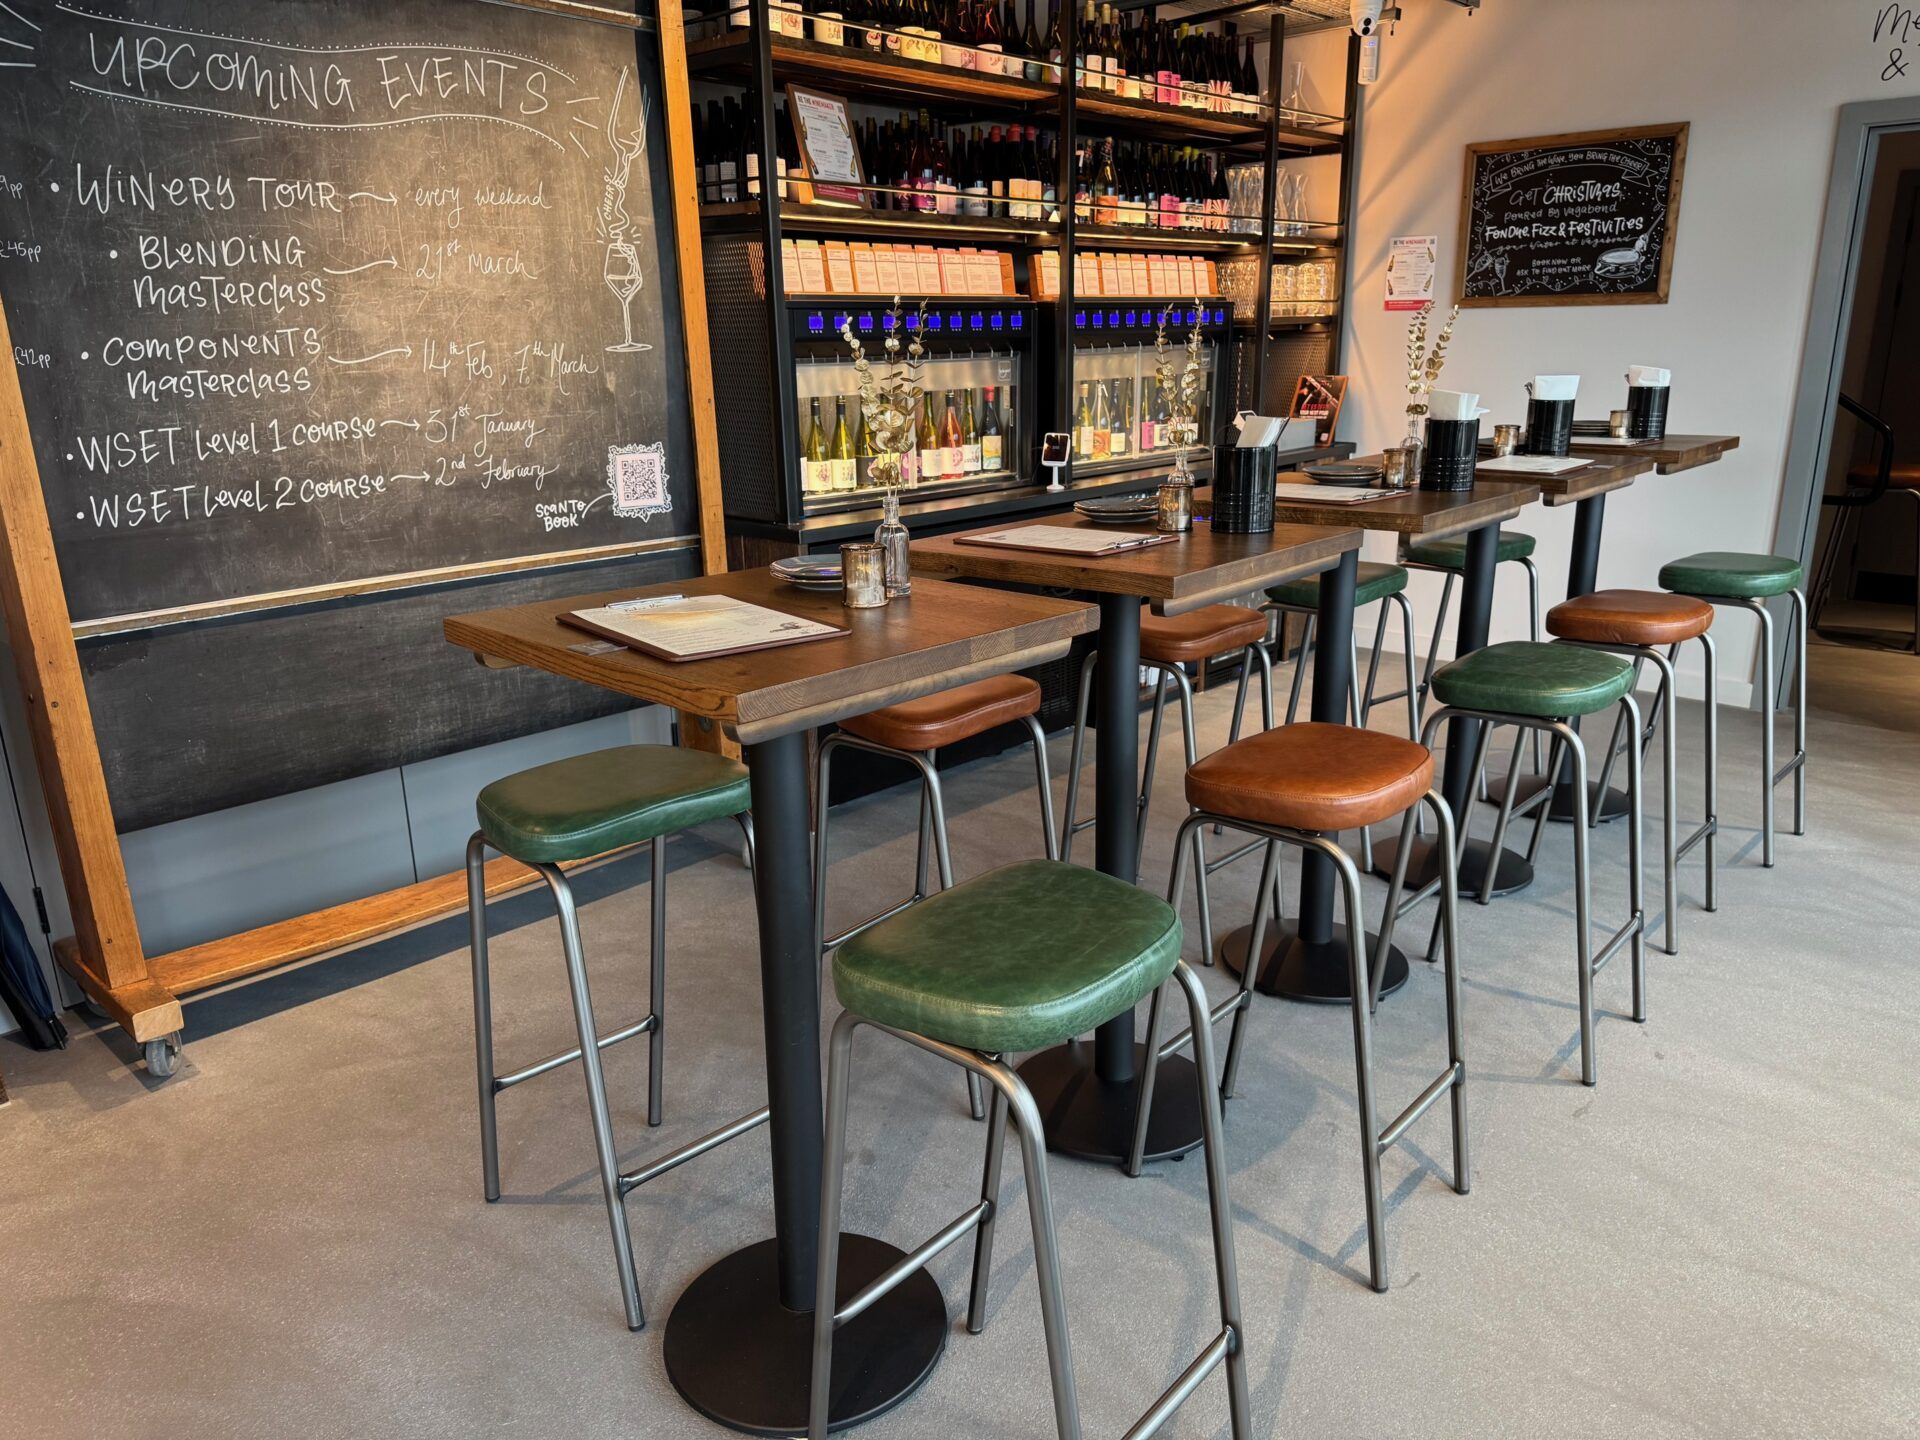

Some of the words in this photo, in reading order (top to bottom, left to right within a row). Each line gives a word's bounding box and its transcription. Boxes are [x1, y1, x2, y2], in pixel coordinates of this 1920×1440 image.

[376, 55, 549, 115] EVENTS
[1881, 48, 1910, 81] &
[415, 187, 464, 229] every
[474, 181, 552, 209] weekend
[1558, 222, 1566, 238] &
[416, 239, 461, 280] 21st
[469, 251, 538, 280] March
[14, 346, 51, 368] £42pp
[423, 338, 463, 378] 14th
[550, 343, 599, 395] March
[77, 427, 182, 475] WSET
[269, 419, 288, 451] 1
[425, 405, 471, 443] 31st
[474, 408, 546, 457] January
[435, 457, 467, 486] 2nd
[474, 458, 560, 490] February
[90, 485, 197, 528] WSET
[275, 476, 297, 510] 2
[543, 513, 579, 532] BOOK
[567, 499, 587, 513] TO
